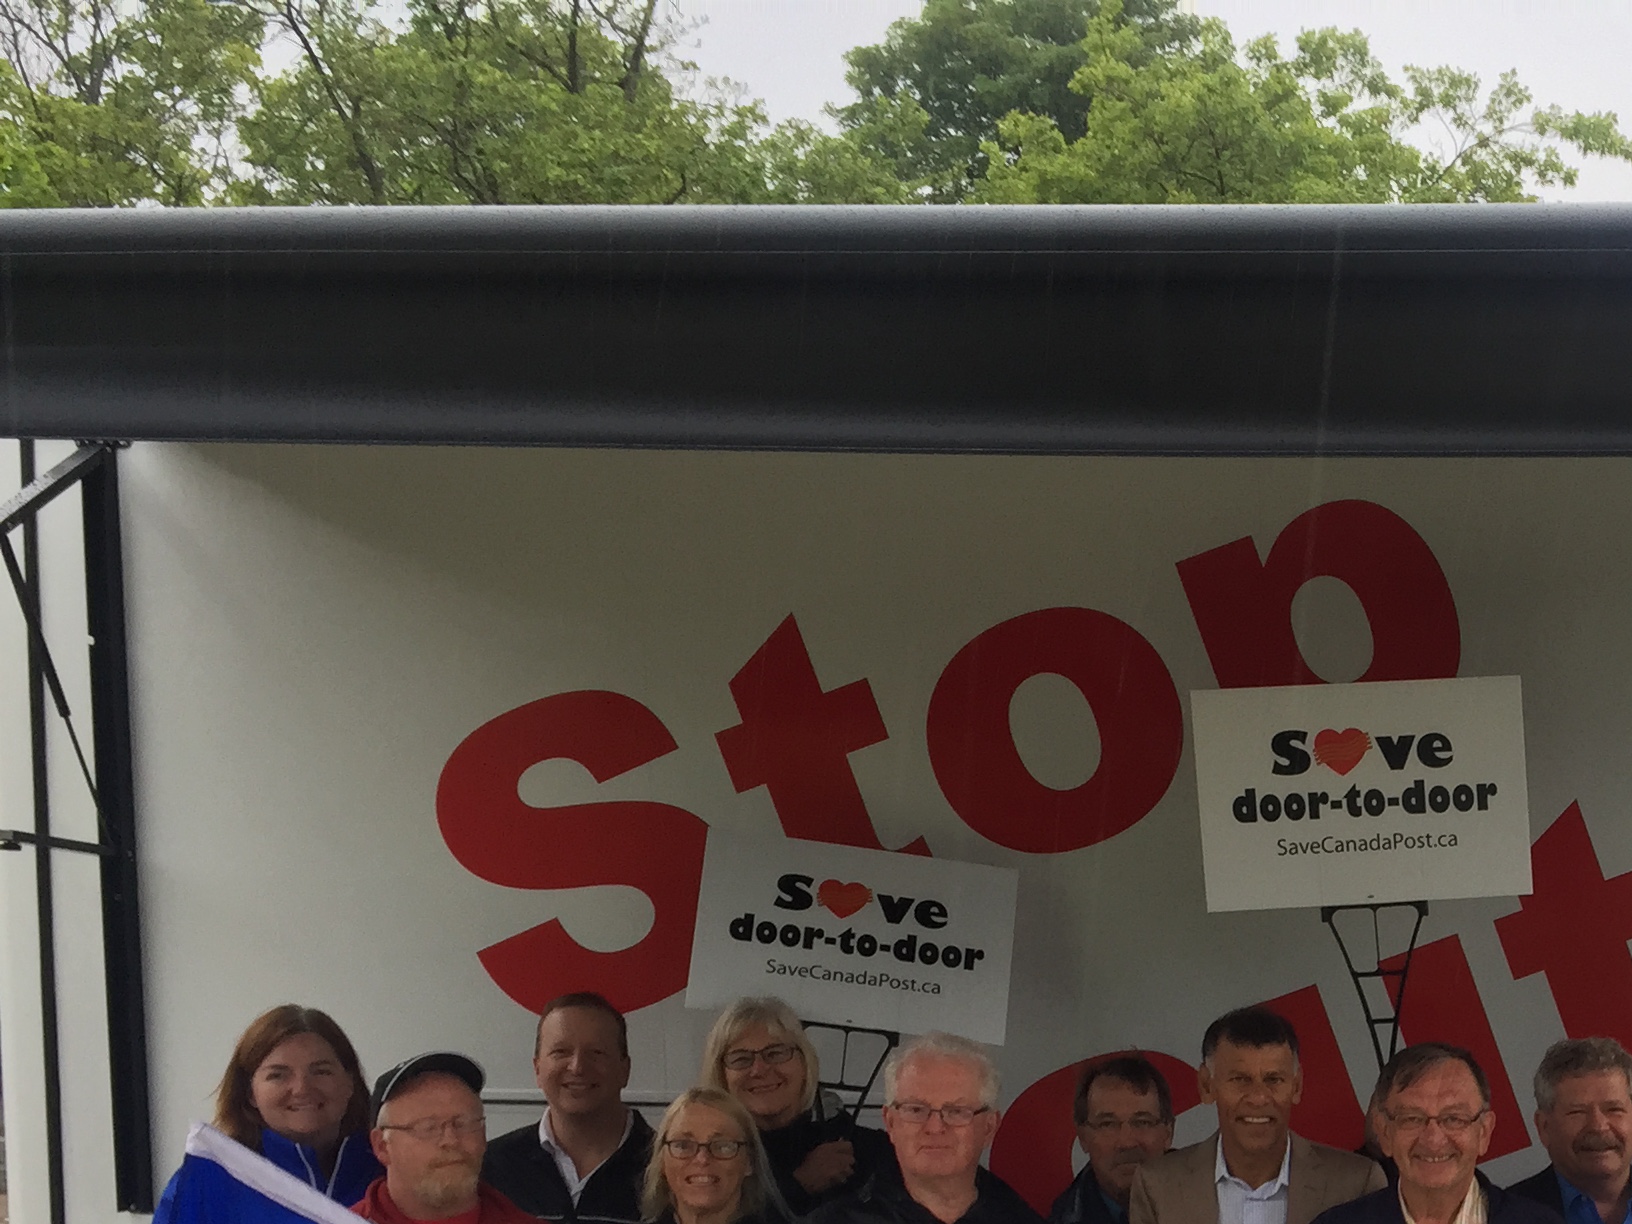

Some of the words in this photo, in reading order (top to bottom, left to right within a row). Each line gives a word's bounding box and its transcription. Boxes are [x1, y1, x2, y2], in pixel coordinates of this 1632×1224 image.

[436, 499, 1463, 1016] Stop
[1271, 728, 1453, 776] Sve
[1232, 780, 1498, 823] door-to-door
[1277, 832, 1459, 856] SaveCanadaPost.ca
[773, 873, 949, 929] Sve
[729, 912, 985, 971] door-to-door
[765, 958, 941, 995] SaveCanadaPost.ca
